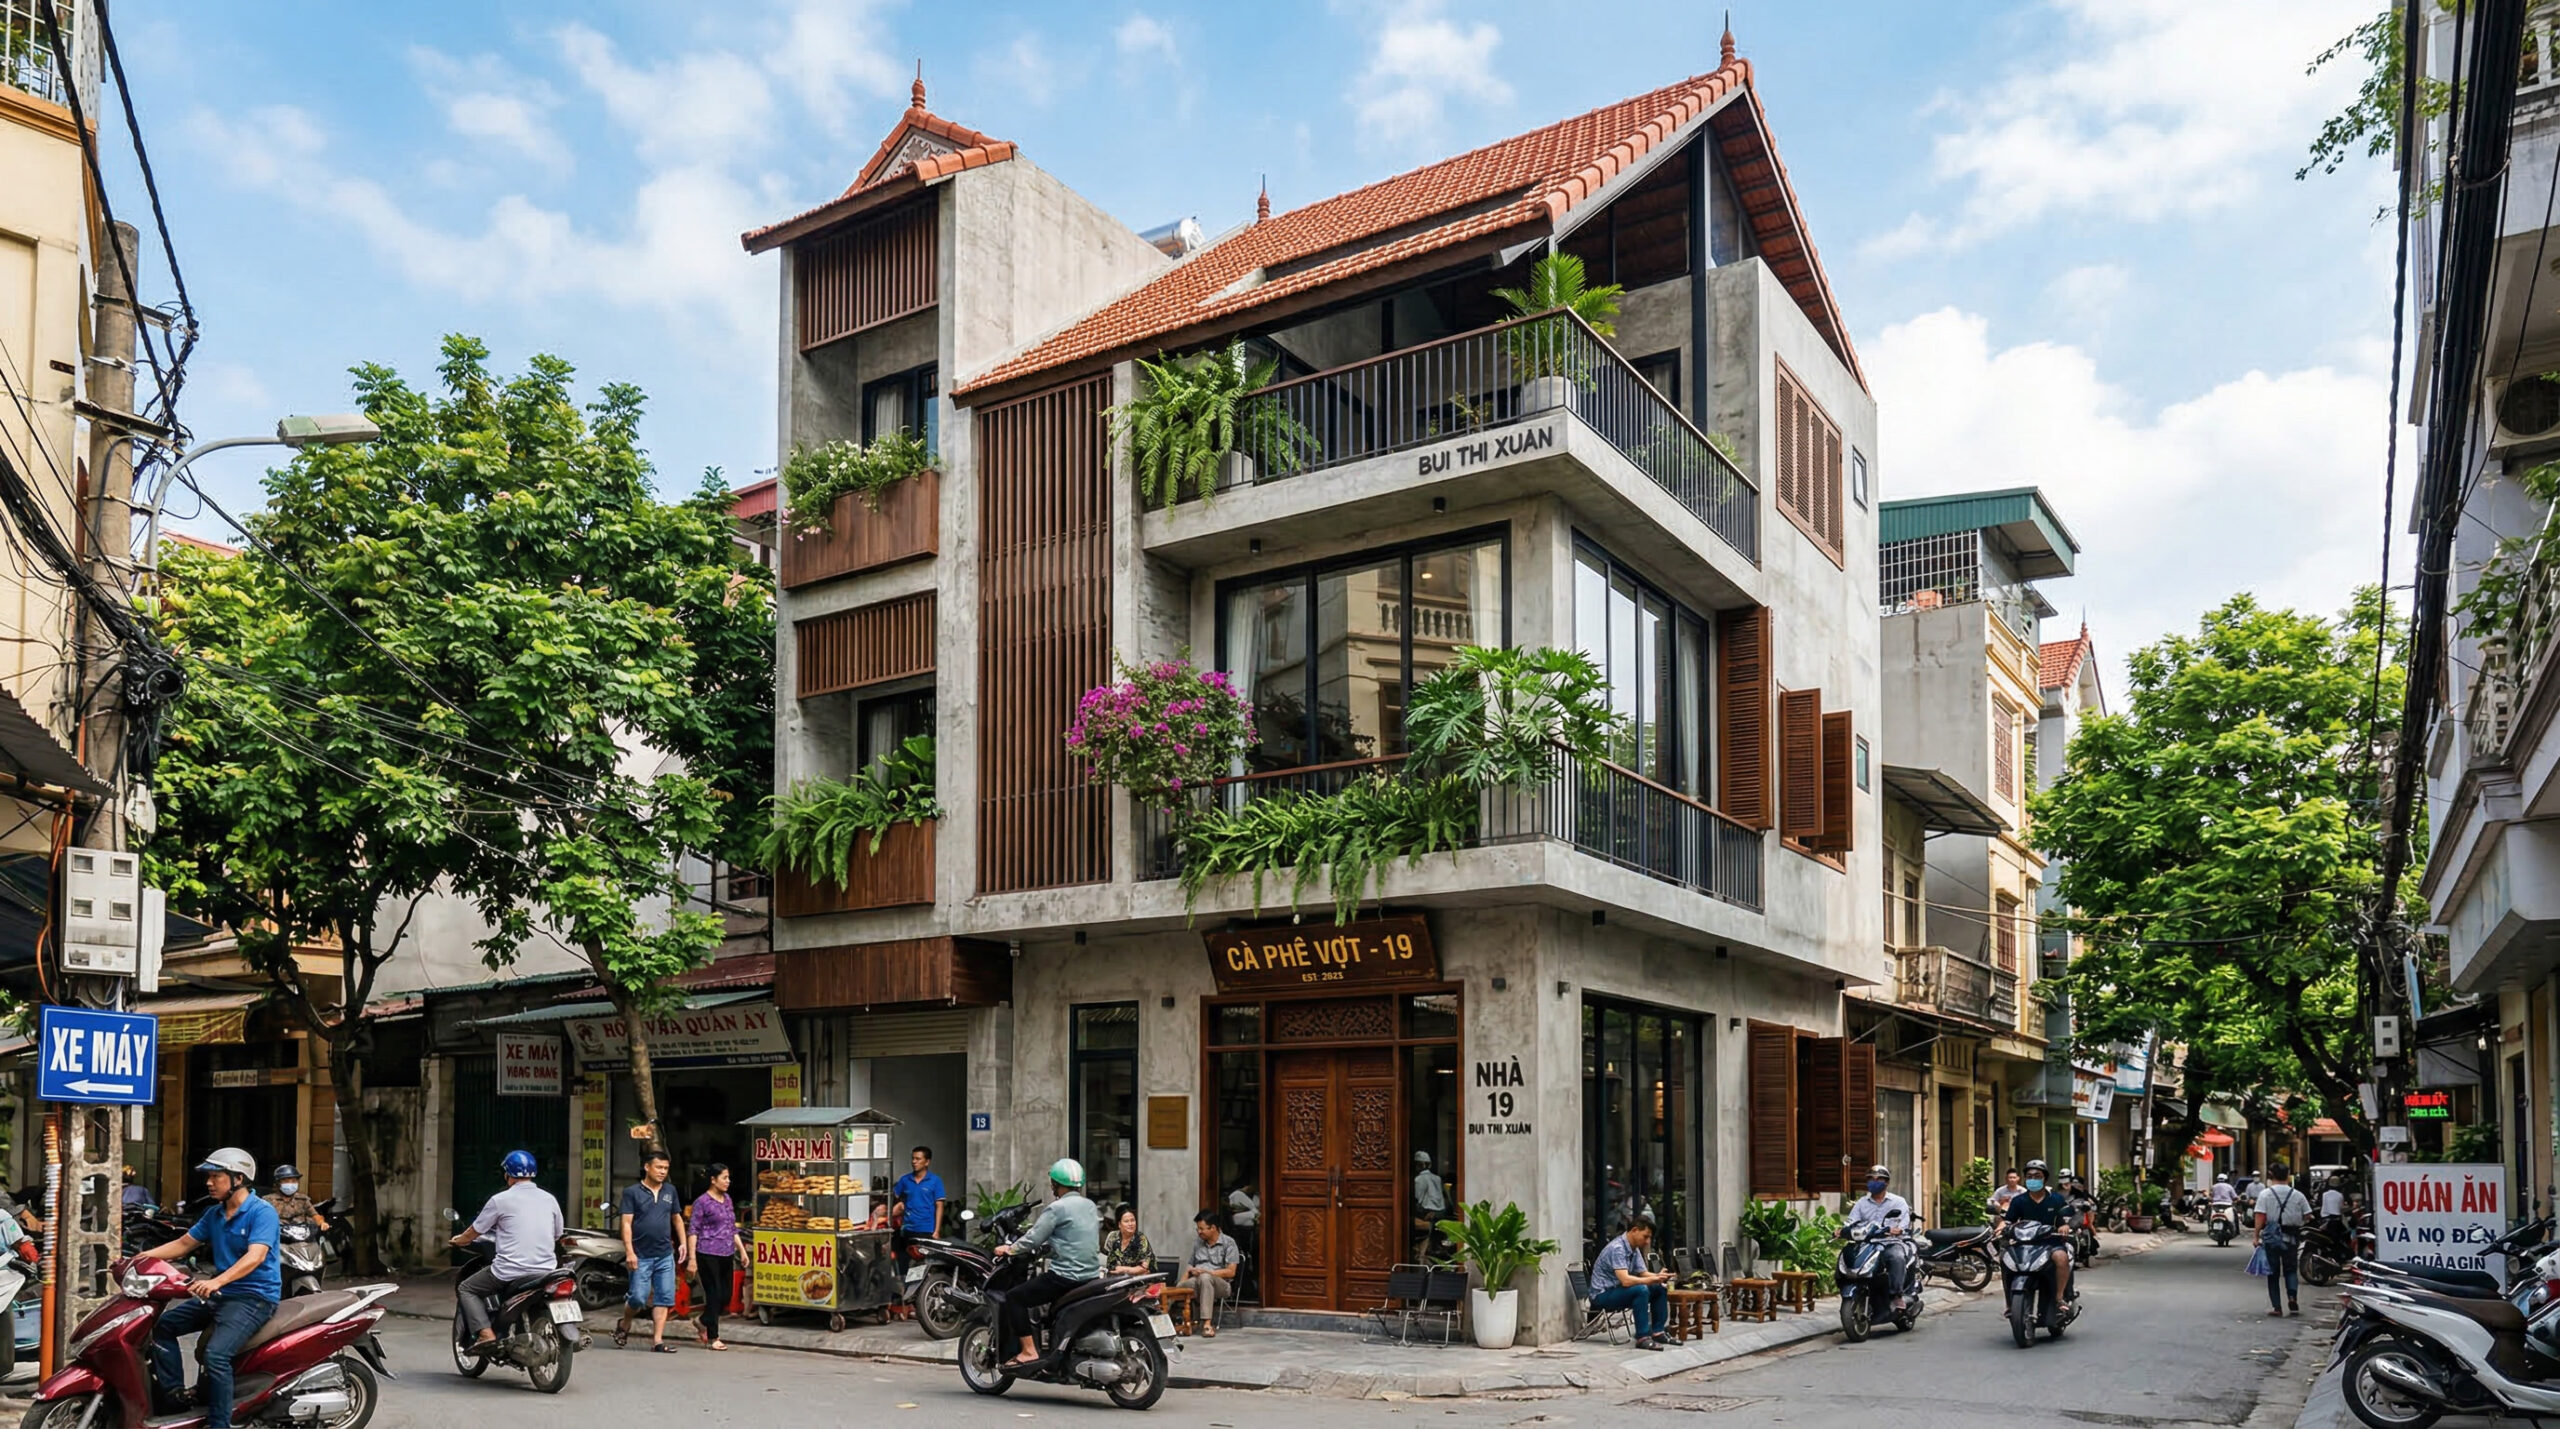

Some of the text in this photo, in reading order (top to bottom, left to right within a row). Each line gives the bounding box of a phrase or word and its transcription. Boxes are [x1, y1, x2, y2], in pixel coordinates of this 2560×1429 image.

[1419, 451, 1450, 475] BUI
[1227, 940, 1260, 972] CÀ
[1263, 936, 1311, 969] PHÊ
[1314, 935, 1361, 969] VỢT
[1383, 934, 1413, 961] 19
[50, 1023, 149, 1077] XE MÁY
[506, 1043, 524, 1060] XE
[1476, 1055, 1524, 1087] NHÀ
[1487, 1091, 1514, 1118] 19
[755, 1131, 833, 1161] BÁNH MÌ
[2383, 1174, 2497, 1215] QUÁN ĂN
[2385, 1223, 2411, 1243] VÀ
[2418, 1227, 2445, 1247] NỌ
[757, 1237, 833, 1268] BÁNH MÌ
